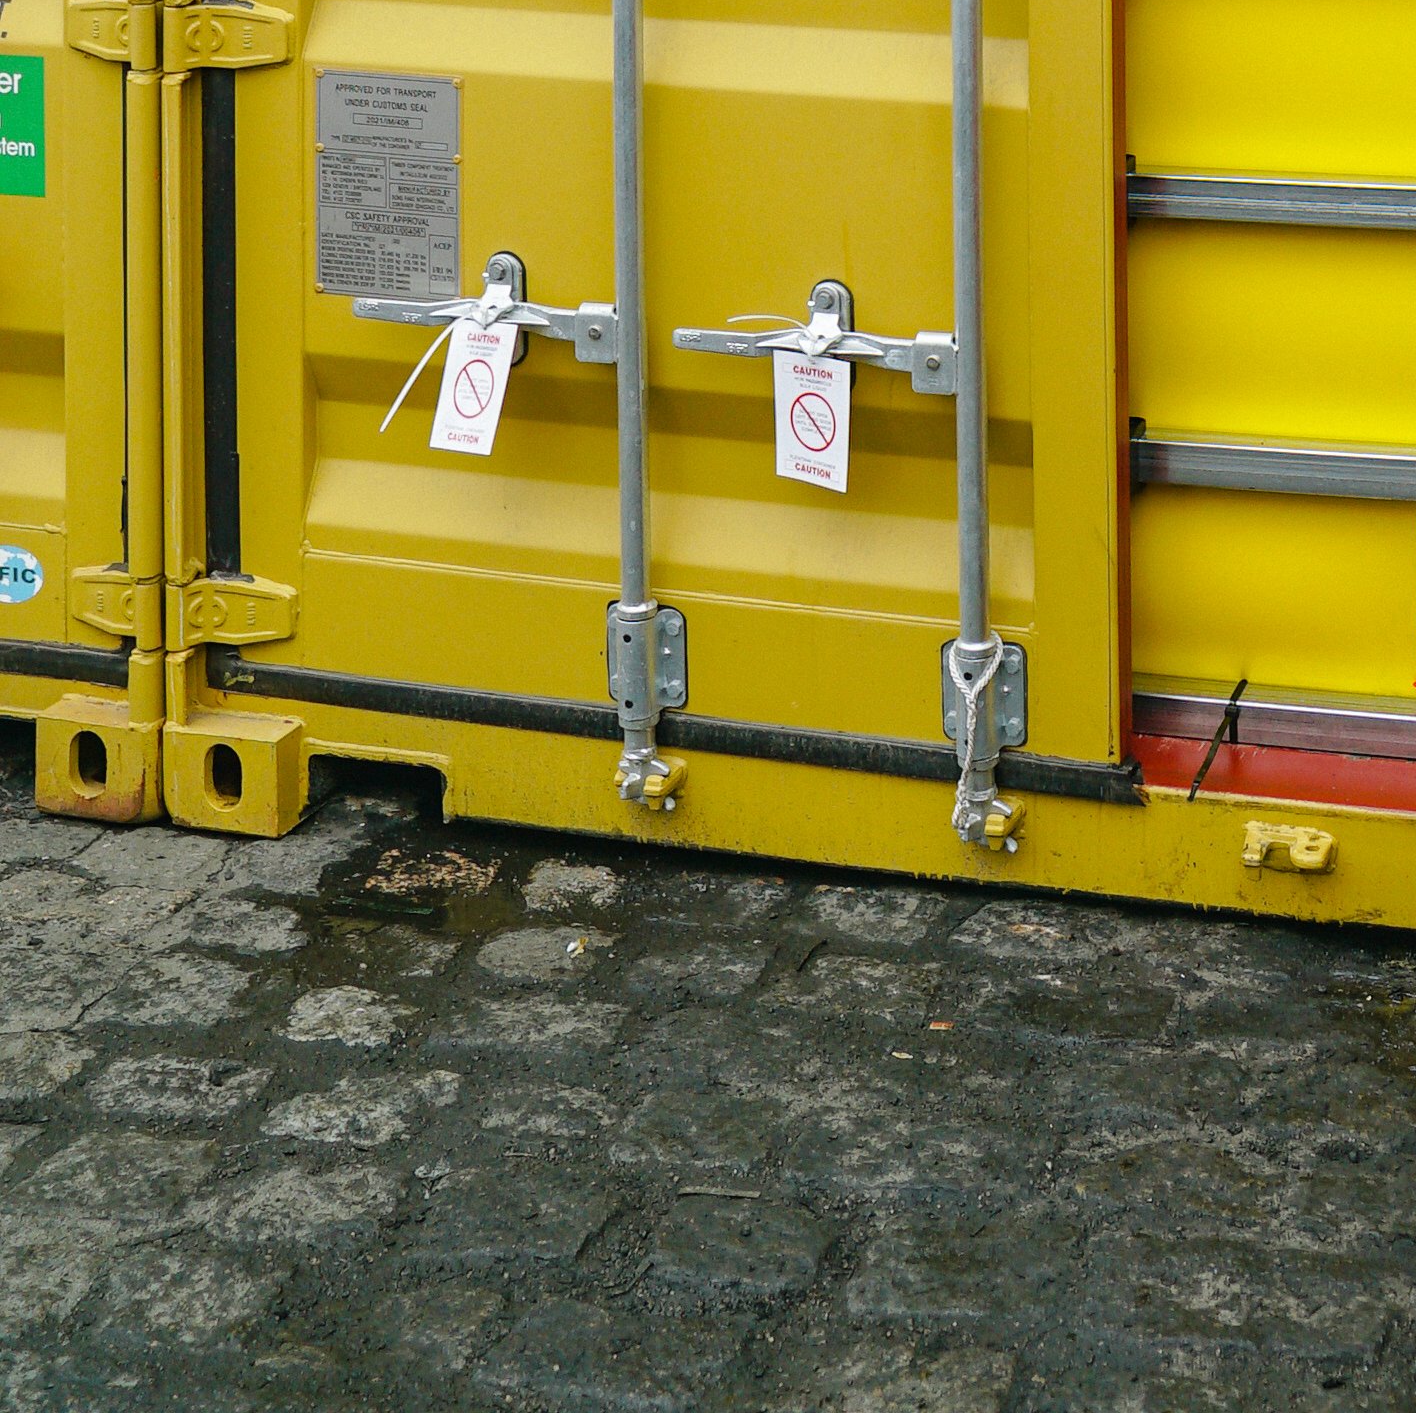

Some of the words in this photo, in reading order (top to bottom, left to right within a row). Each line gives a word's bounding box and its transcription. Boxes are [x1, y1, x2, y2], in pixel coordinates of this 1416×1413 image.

[335, 84, 374, 95] APPROVED
[376, 87, 391, 95] FOR
[393, 88, 437, 99] TRANSPORT
[344, 98, 370, 107] UNDER
[372, 100, 408, 111] CUSTOMS
[410, 103, 429, 113] SEAL
[345, 210, 361, 220] CSC
[363, 212, 390, 222] SAFETY
[393, 215, 430, 227] APPROVAL
[467, 333, 501, 344] CAUTION
[793, 365, 833, 380] CAUTION
[447, 432, 480, 444] CAUTION
[795, 462, 831, 479] CAUTION
